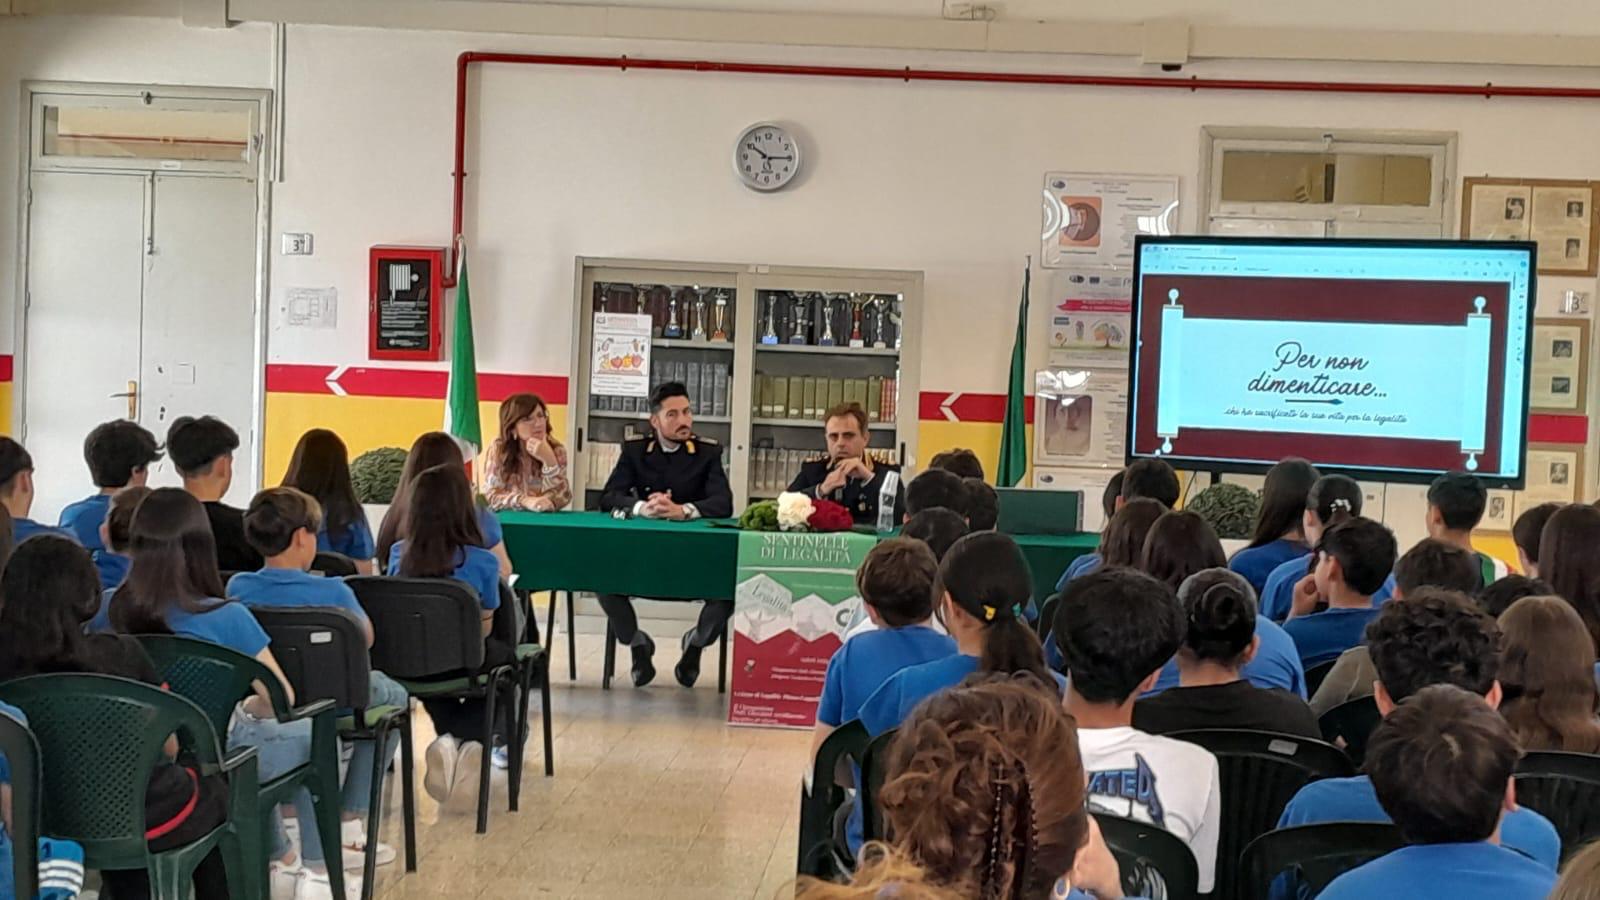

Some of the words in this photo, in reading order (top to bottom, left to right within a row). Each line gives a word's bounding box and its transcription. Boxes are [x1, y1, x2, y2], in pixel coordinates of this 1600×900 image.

[1272, 341, 1321, 372] Per
[1325, 354, 1369, 371] non
[1247, 371, 1387, 398] dimenticare...
[761, 546, 775, 559] DI
[762, 533, 850, 551] SENTINELLE
